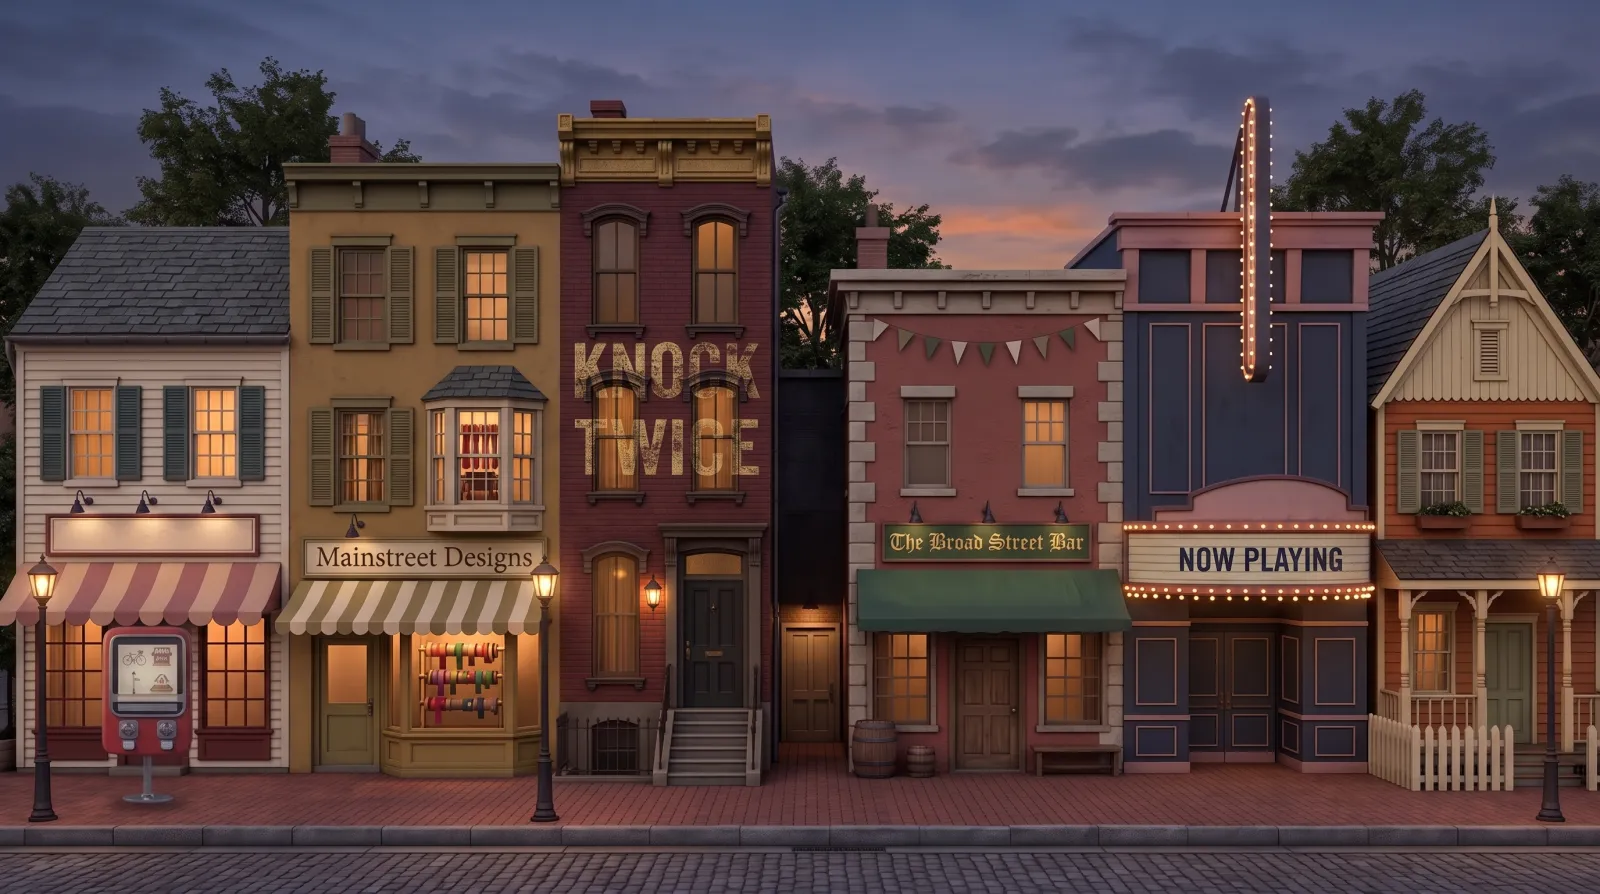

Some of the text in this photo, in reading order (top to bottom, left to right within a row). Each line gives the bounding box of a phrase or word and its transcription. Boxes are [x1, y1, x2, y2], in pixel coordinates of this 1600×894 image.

[574, 341, 760, 399] KNOCK
[574, 418, 760, 476] TWICE
[889, 532, 1084, 553] The Broad Street Bar
[316, 546, 533, 573] Mainstreet Designs
[1179, 546, 1343, 572] NOW PLAYING
